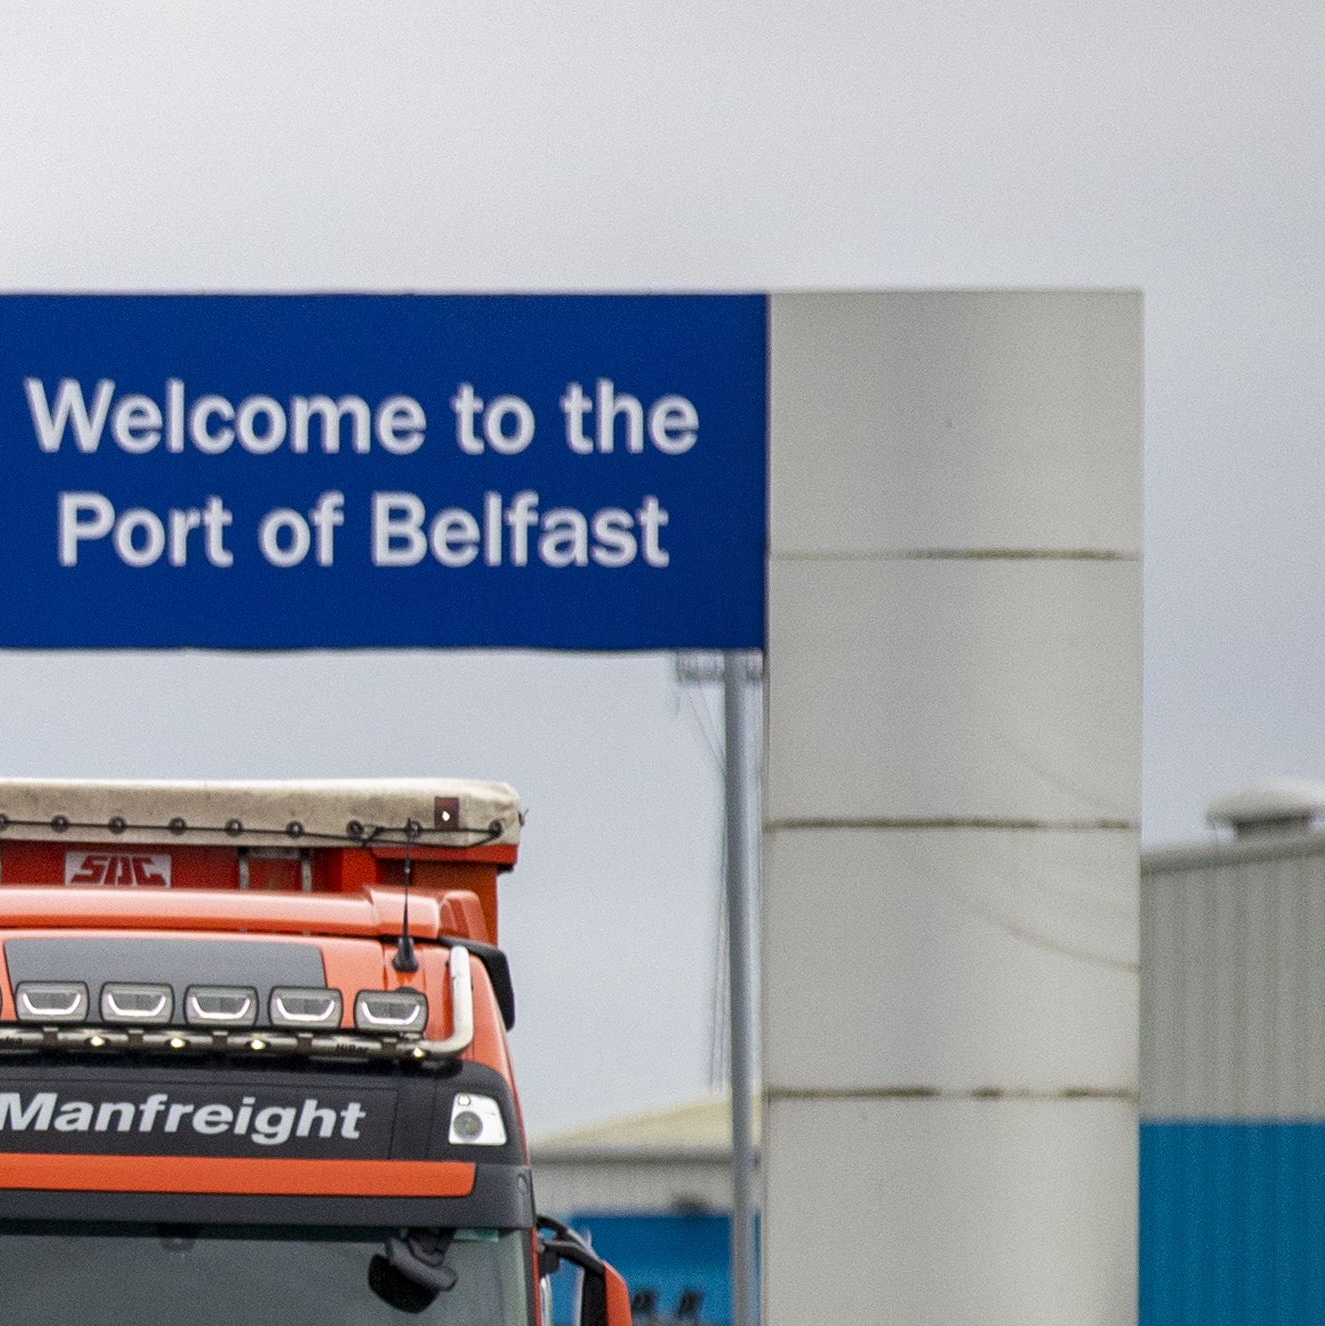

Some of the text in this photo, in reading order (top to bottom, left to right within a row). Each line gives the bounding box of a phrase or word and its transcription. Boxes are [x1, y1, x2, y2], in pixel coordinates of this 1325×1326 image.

[26, 379, 699, 454] Welcome to the
[59, 492, 669, 567] Port of Belfast
